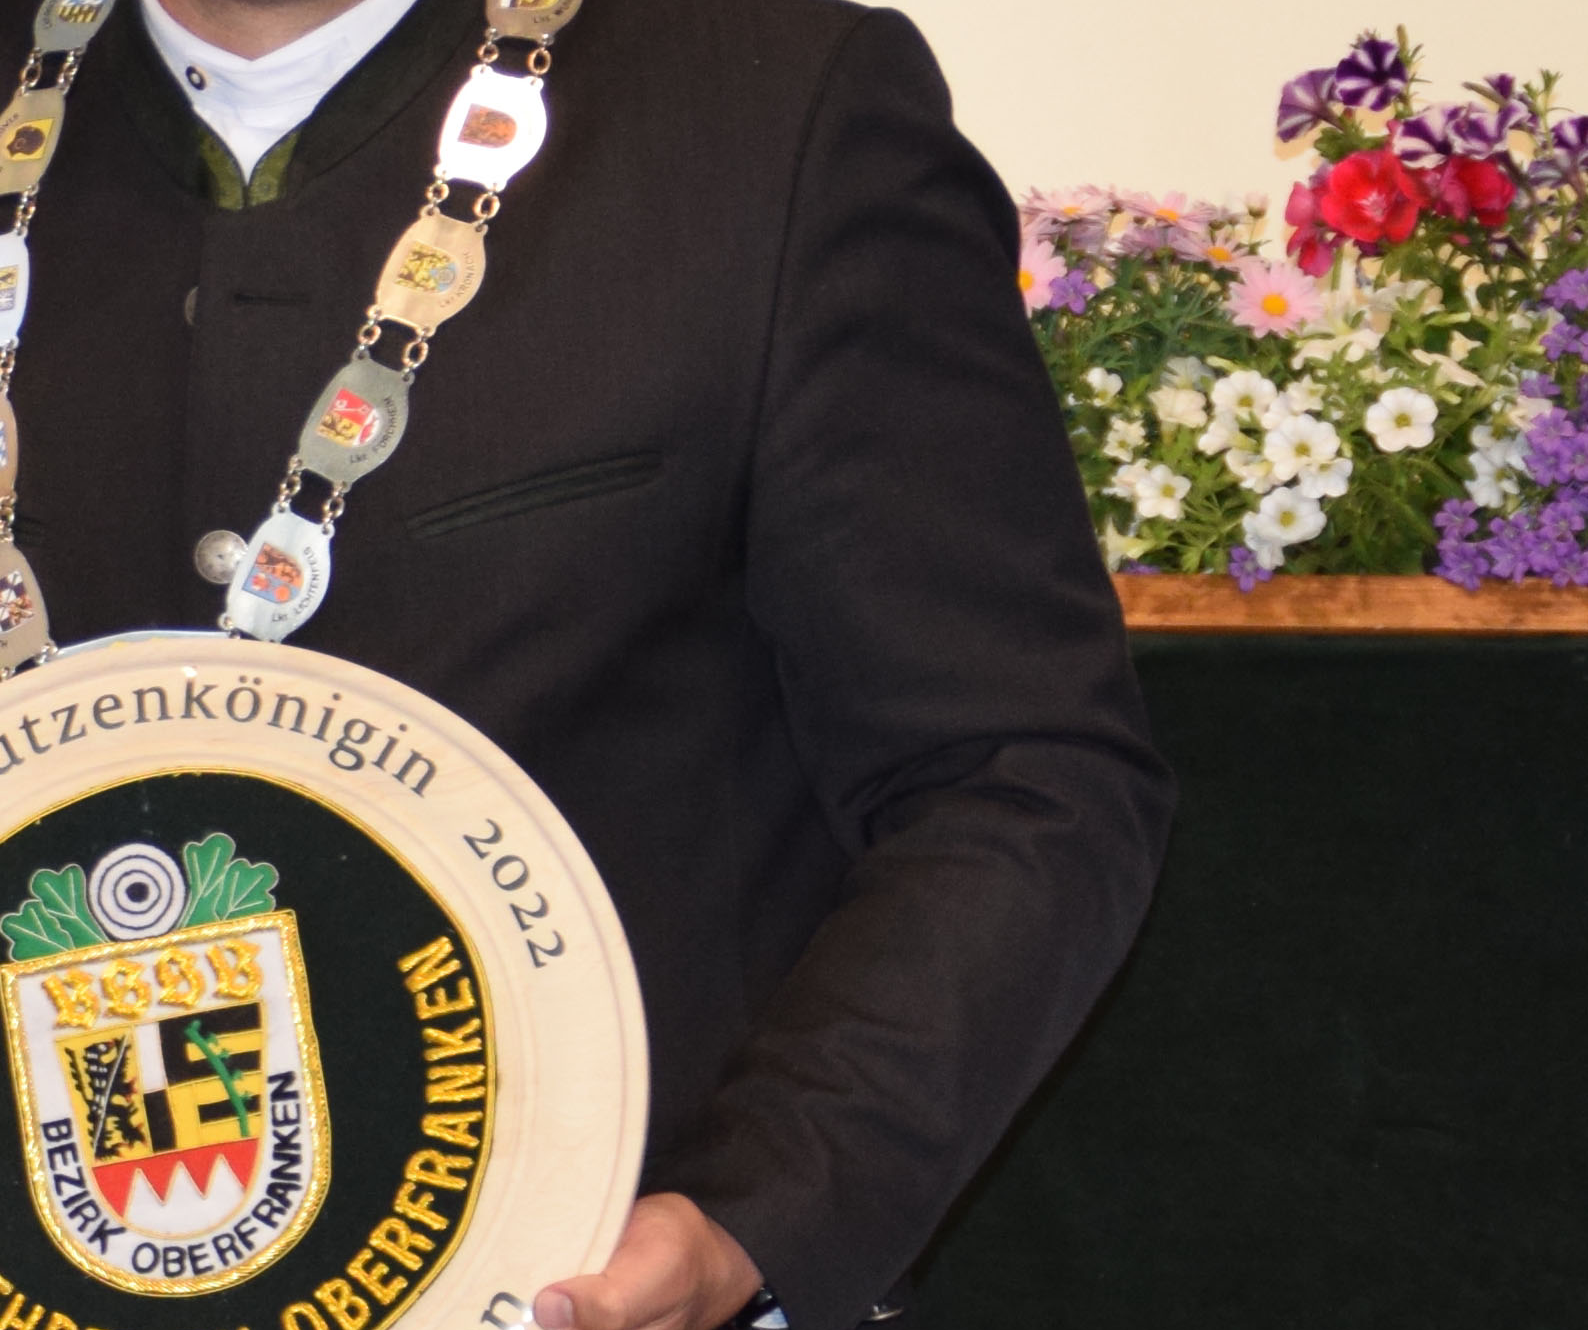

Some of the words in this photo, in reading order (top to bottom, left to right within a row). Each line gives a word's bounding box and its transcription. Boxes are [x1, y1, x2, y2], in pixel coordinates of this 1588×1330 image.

[462, 818, 565, 969] 2022
[41, 937, 264, 1030] BSSB
[40, 1117, 127, 1256] BEZIRK
[131, 1070, 302, 1277] OBERFRANKEN
